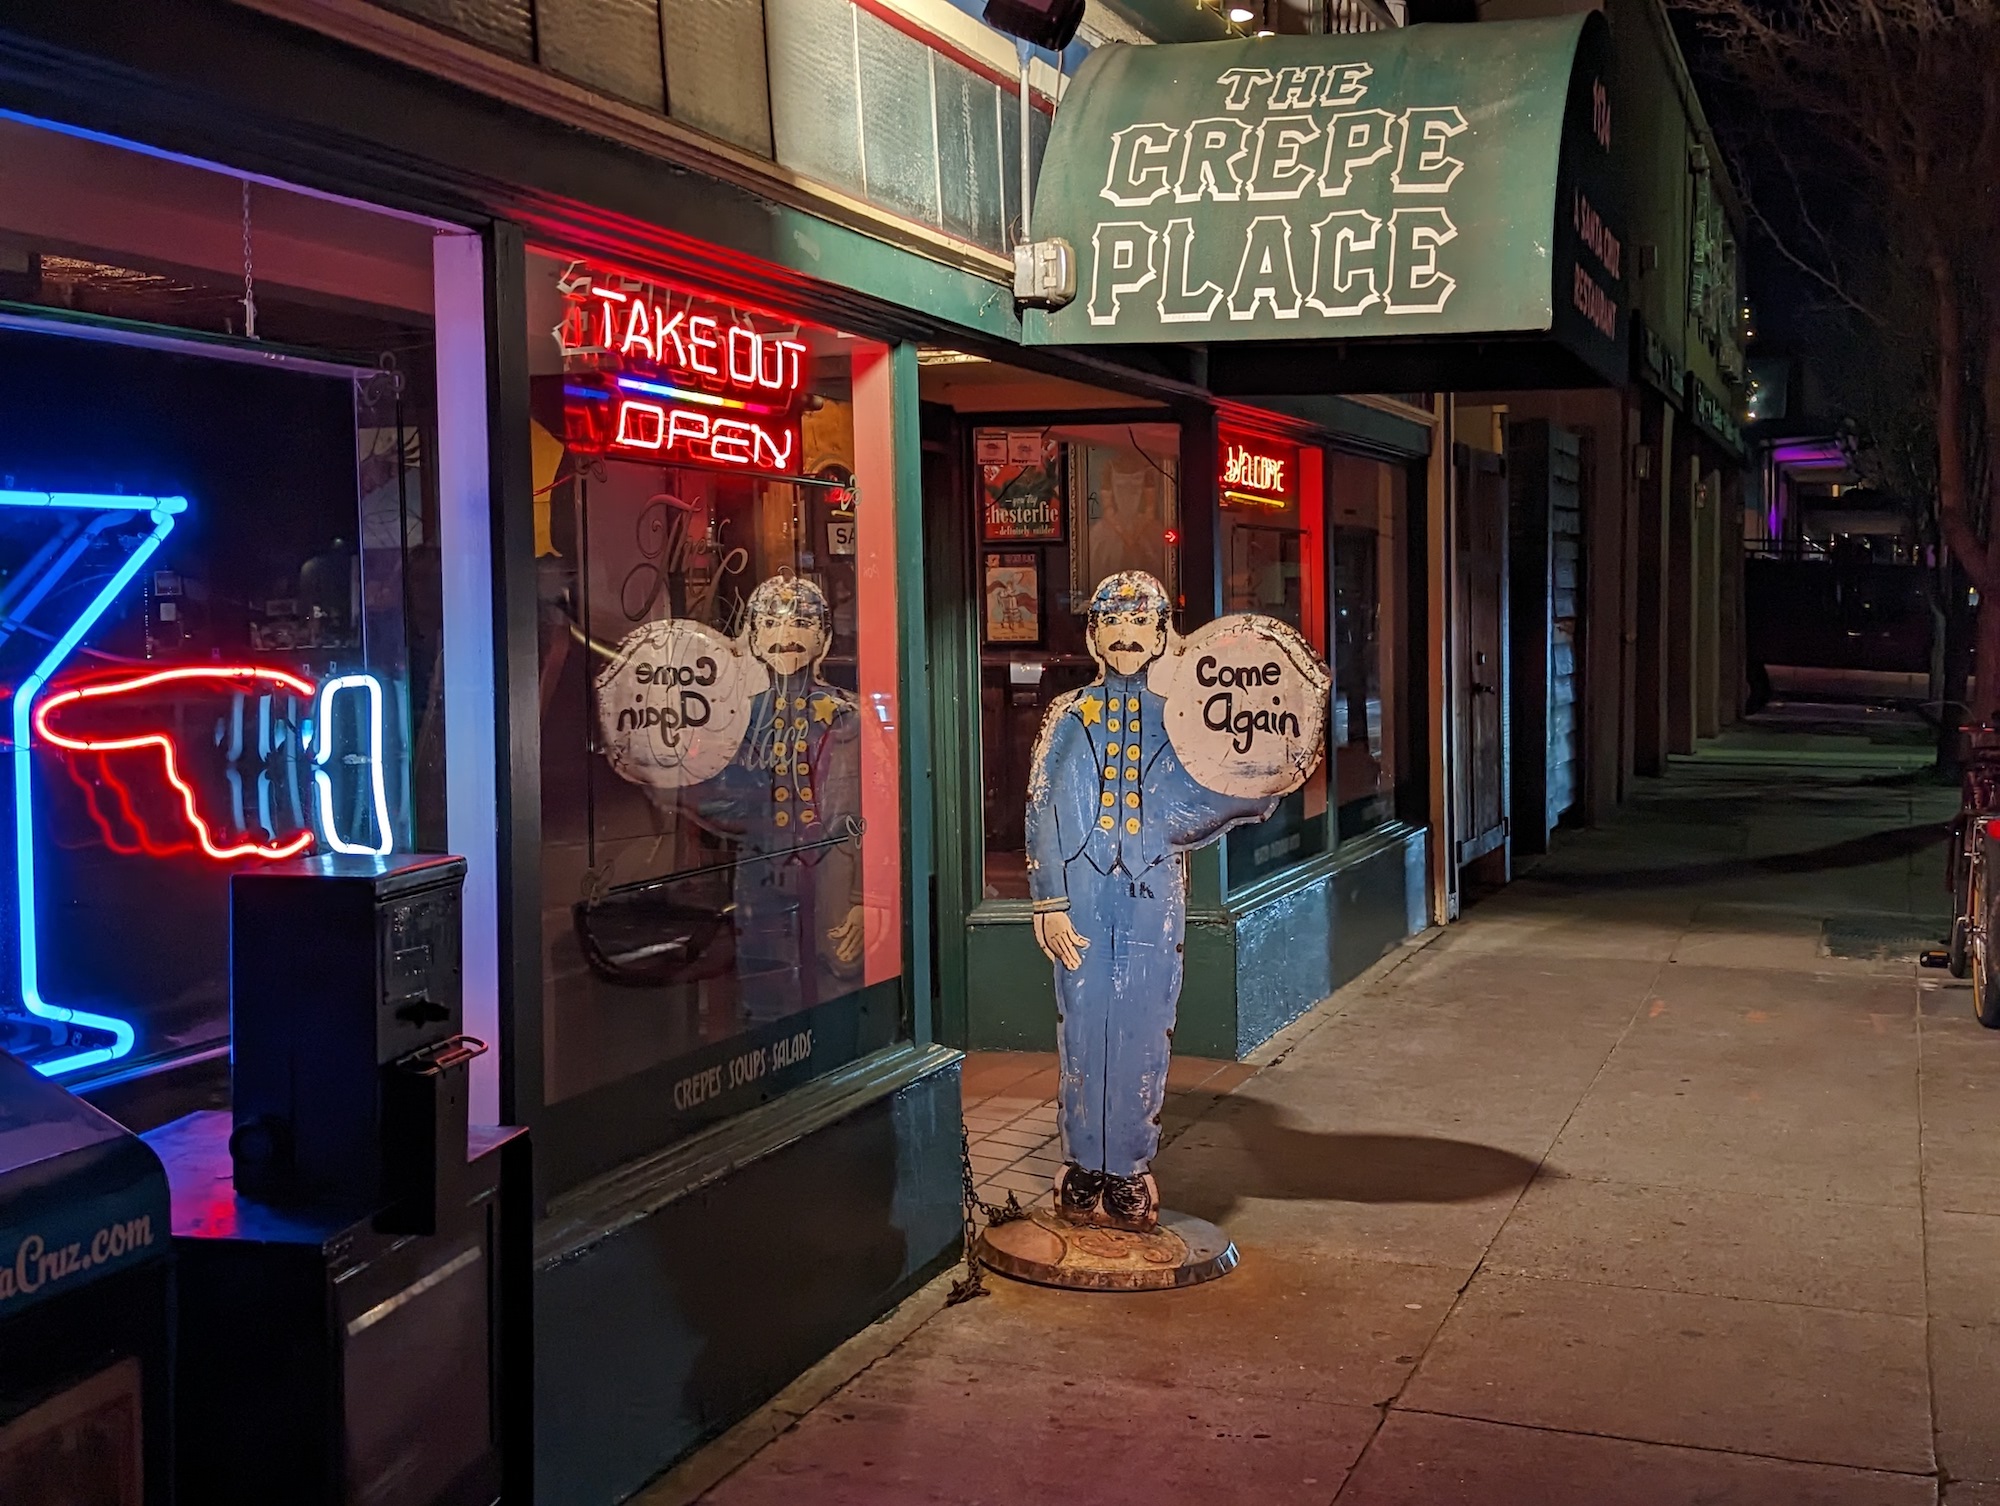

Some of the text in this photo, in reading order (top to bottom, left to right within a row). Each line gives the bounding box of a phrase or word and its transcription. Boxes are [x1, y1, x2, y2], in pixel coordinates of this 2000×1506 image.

[1217, 62, 1374, 110] THE
[1100, 106, 1469, 207] CREPE
[1087, 207, 1458, 325] PLACE
[592, 286, 717, 376] TAKE
[728, 326, 807, 389] OUT
[615, 401, 792, 469] OPEN
[1196, 655, 1281, 695] Come
[673, 1028, 813, 1111] CREPES SOUPS SALADS
